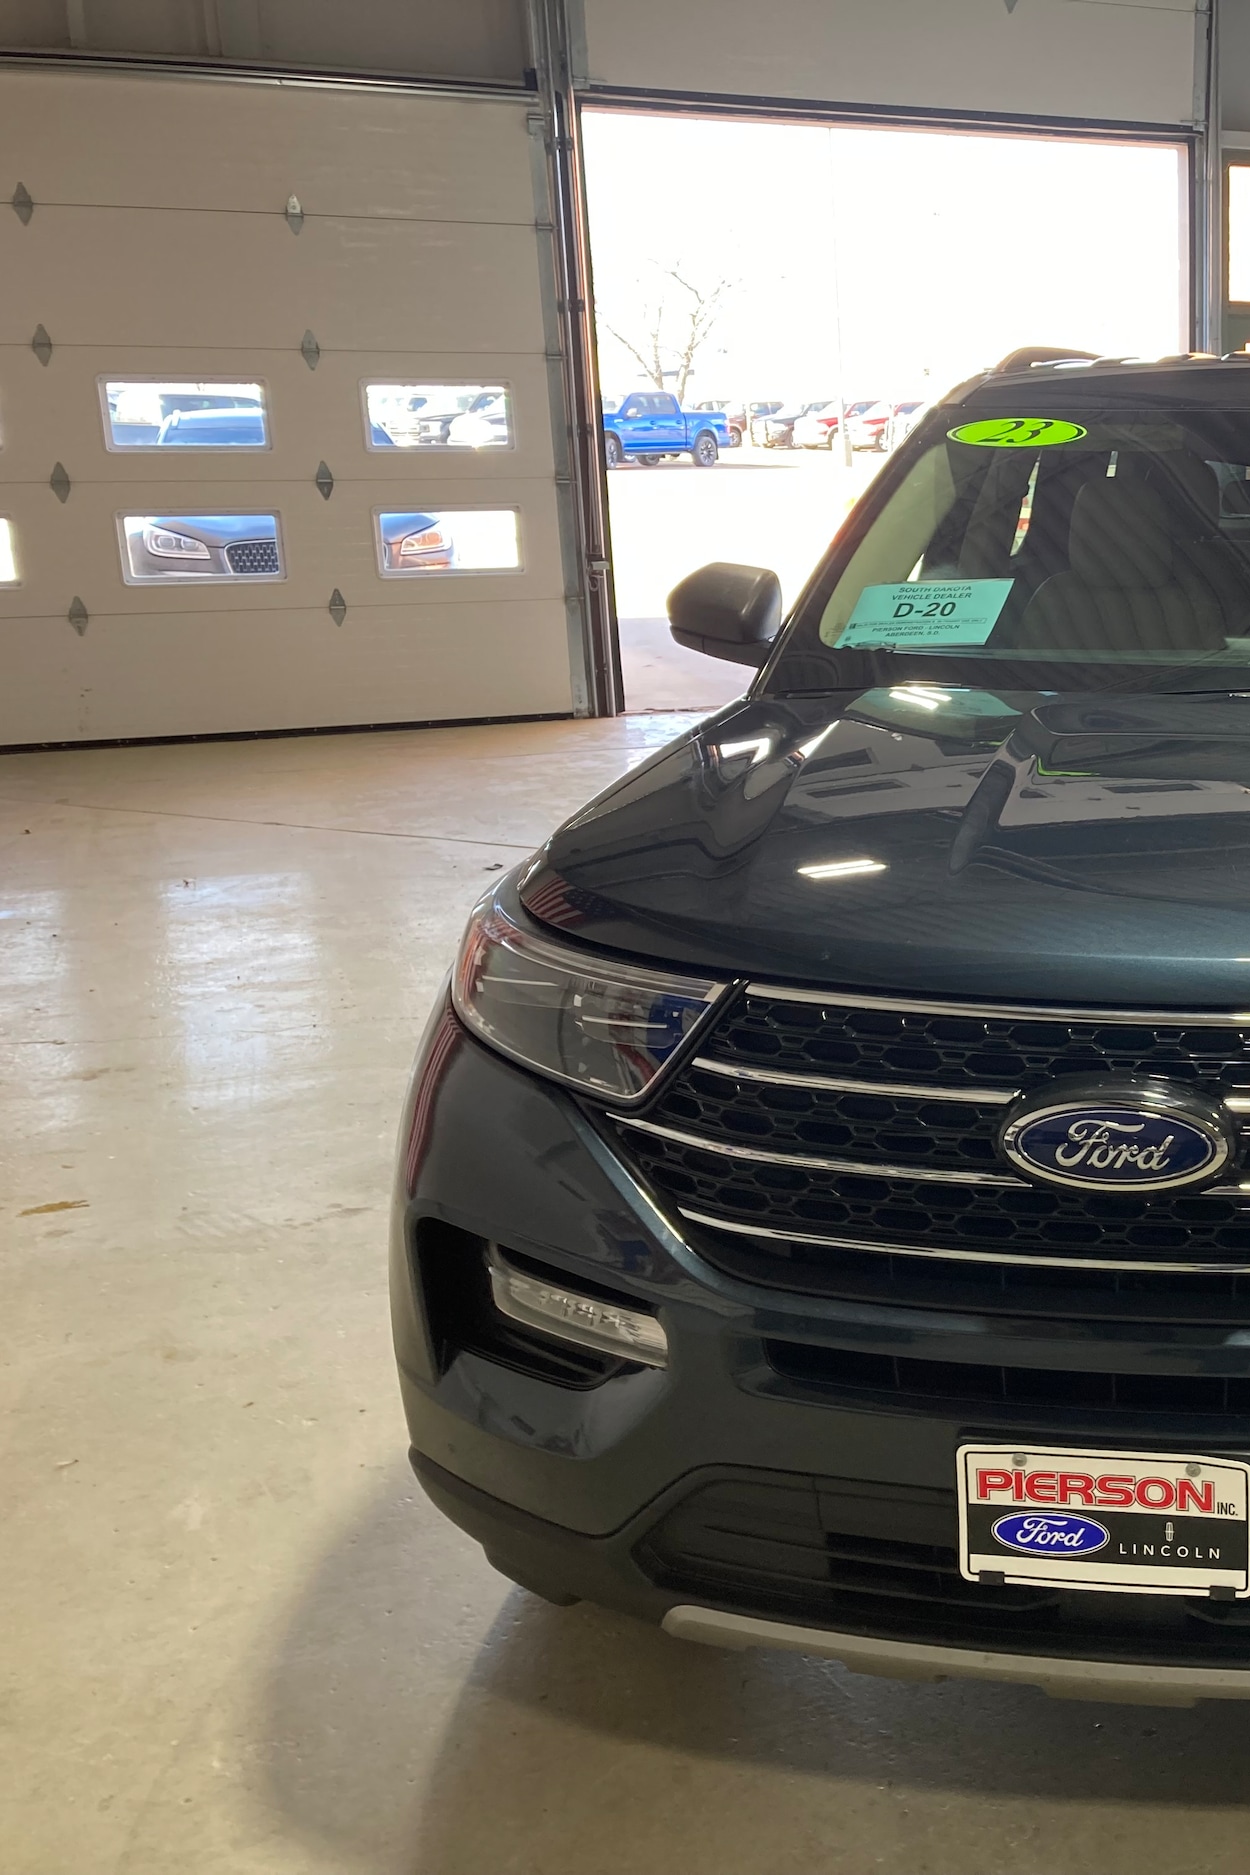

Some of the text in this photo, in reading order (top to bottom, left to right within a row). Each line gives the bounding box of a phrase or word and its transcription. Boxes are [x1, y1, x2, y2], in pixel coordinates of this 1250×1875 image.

[975, 420, 1054, 443] 23
[892, 592, 972, 601] VEHICLE DEALER
[933, 585, 972, 593] DAKOTA
[892, 602, 957, 619] D-20
[1055, 1119, 1175, 1171] Ford
[976, 1468, 1239, 1517] PIERSON INC.
[1015, 1516, 1221, 1560] Ford LINCOLN
